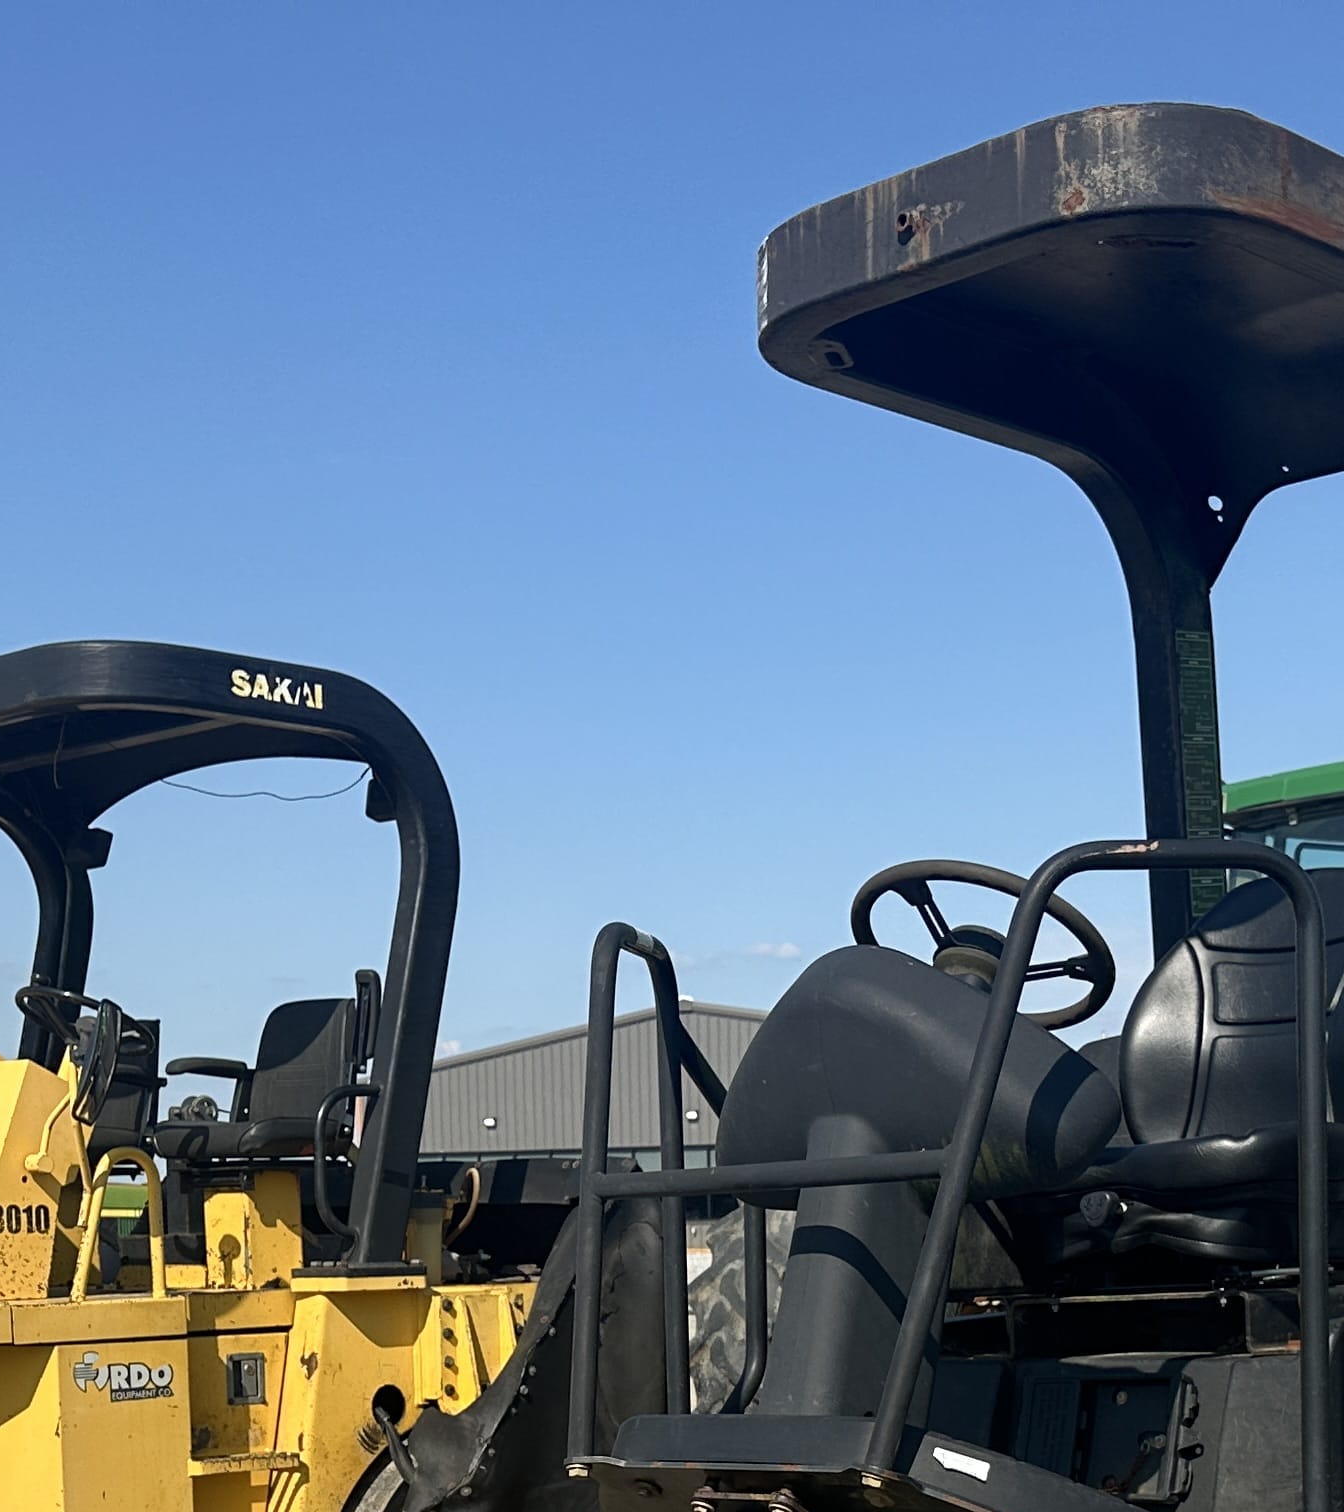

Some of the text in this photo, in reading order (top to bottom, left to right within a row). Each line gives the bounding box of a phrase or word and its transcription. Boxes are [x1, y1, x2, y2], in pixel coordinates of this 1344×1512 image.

[231, 669, 324, 710] SAKAI
[109, 1363, 174, 1390] RDO
[112, 1389, 156, 1401] EQUIPMENT
